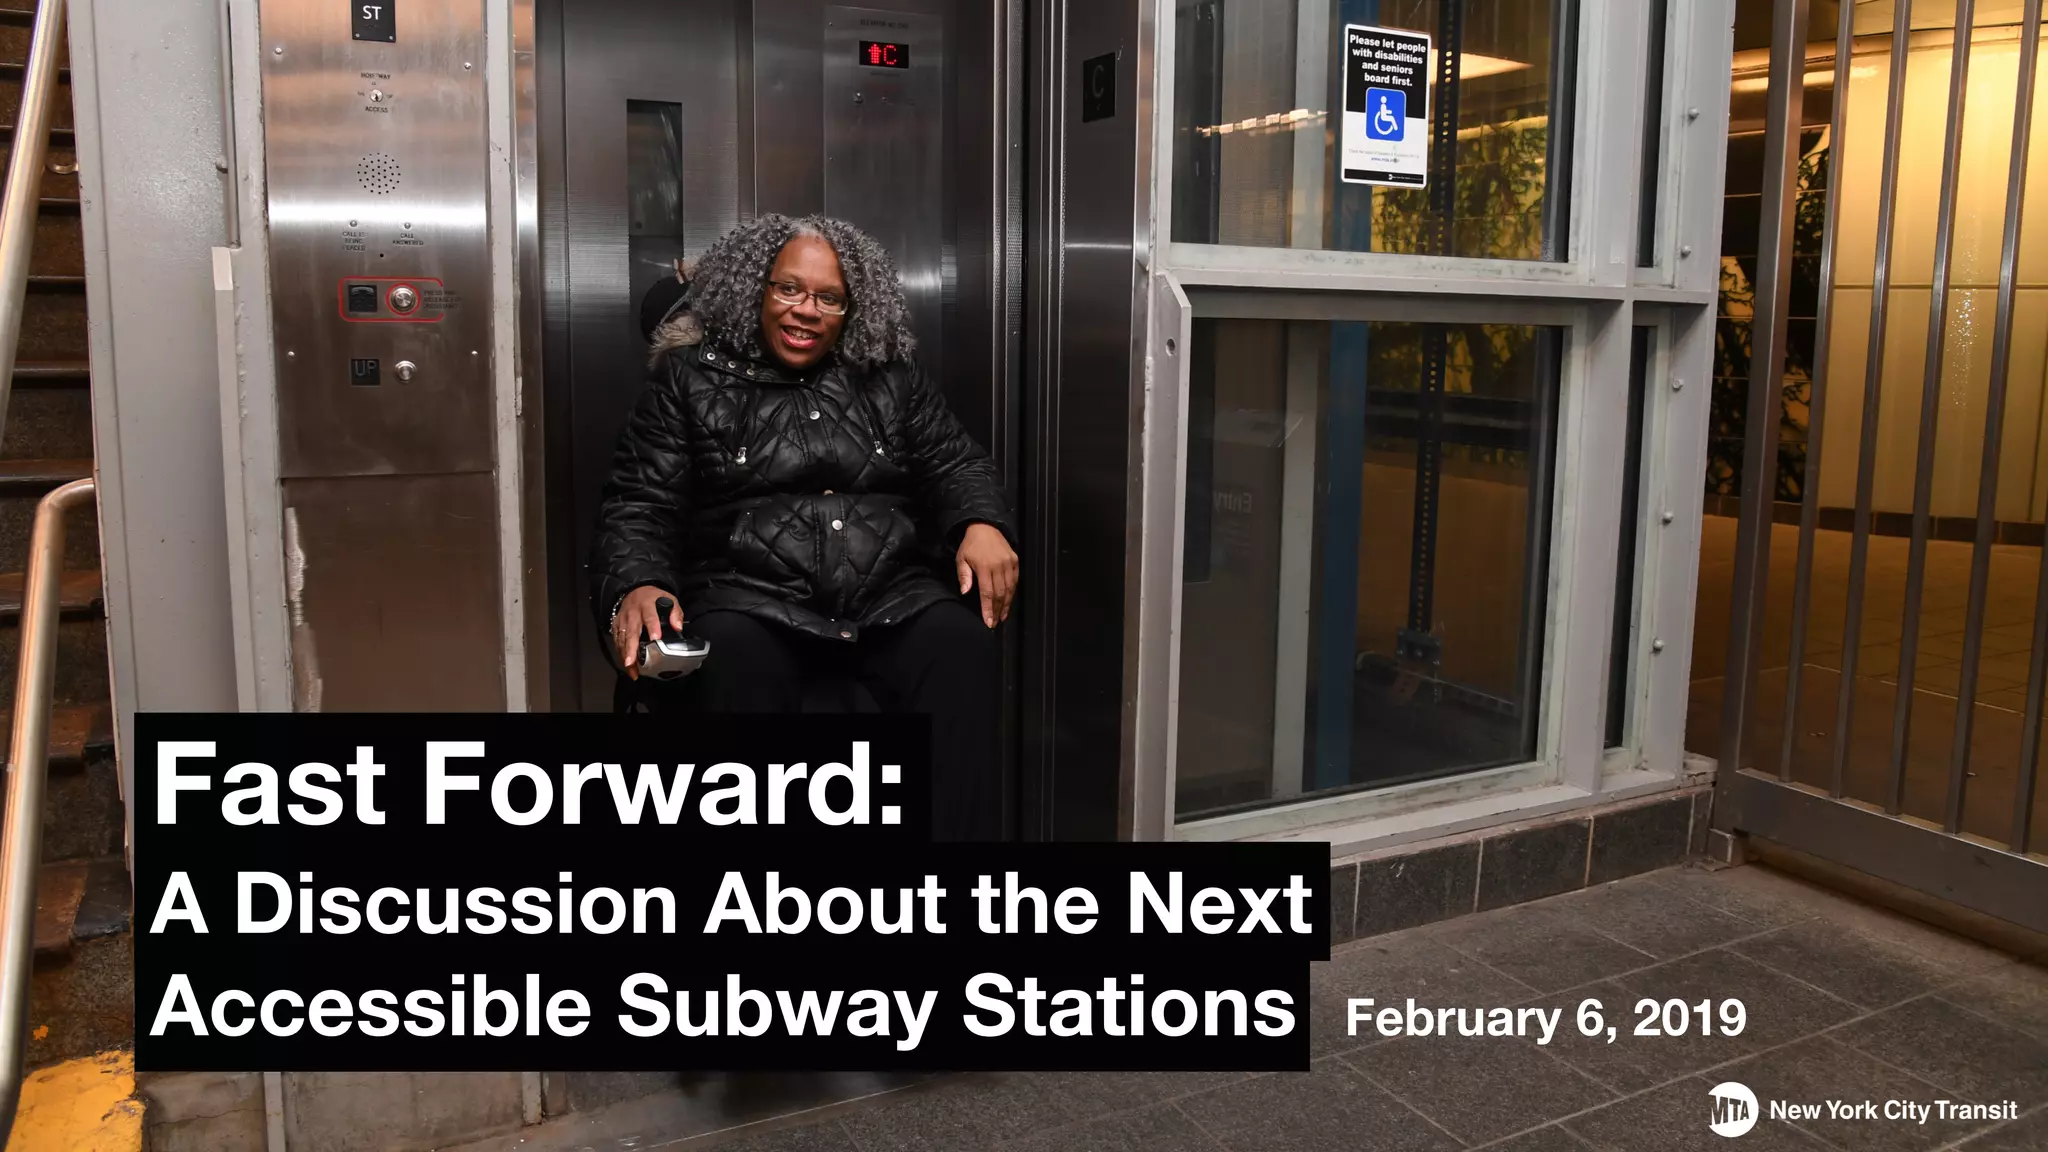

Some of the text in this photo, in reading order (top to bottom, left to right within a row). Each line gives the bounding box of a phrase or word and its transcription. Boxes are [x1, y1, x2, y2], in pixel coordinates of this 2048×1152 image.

[362, 5, 382, 20] ST
[1349, 34, 1426, 53] Please let people
[883, 45, 897, 65] C
[1352, 48, 1423, 64] with disabilities
[1361, 61, 1413, 75] and seniors
[1092, 64, 1104, 98] C
[1364, 72, 1413, 87] board first.
[354, 359, 378, 377] UP
